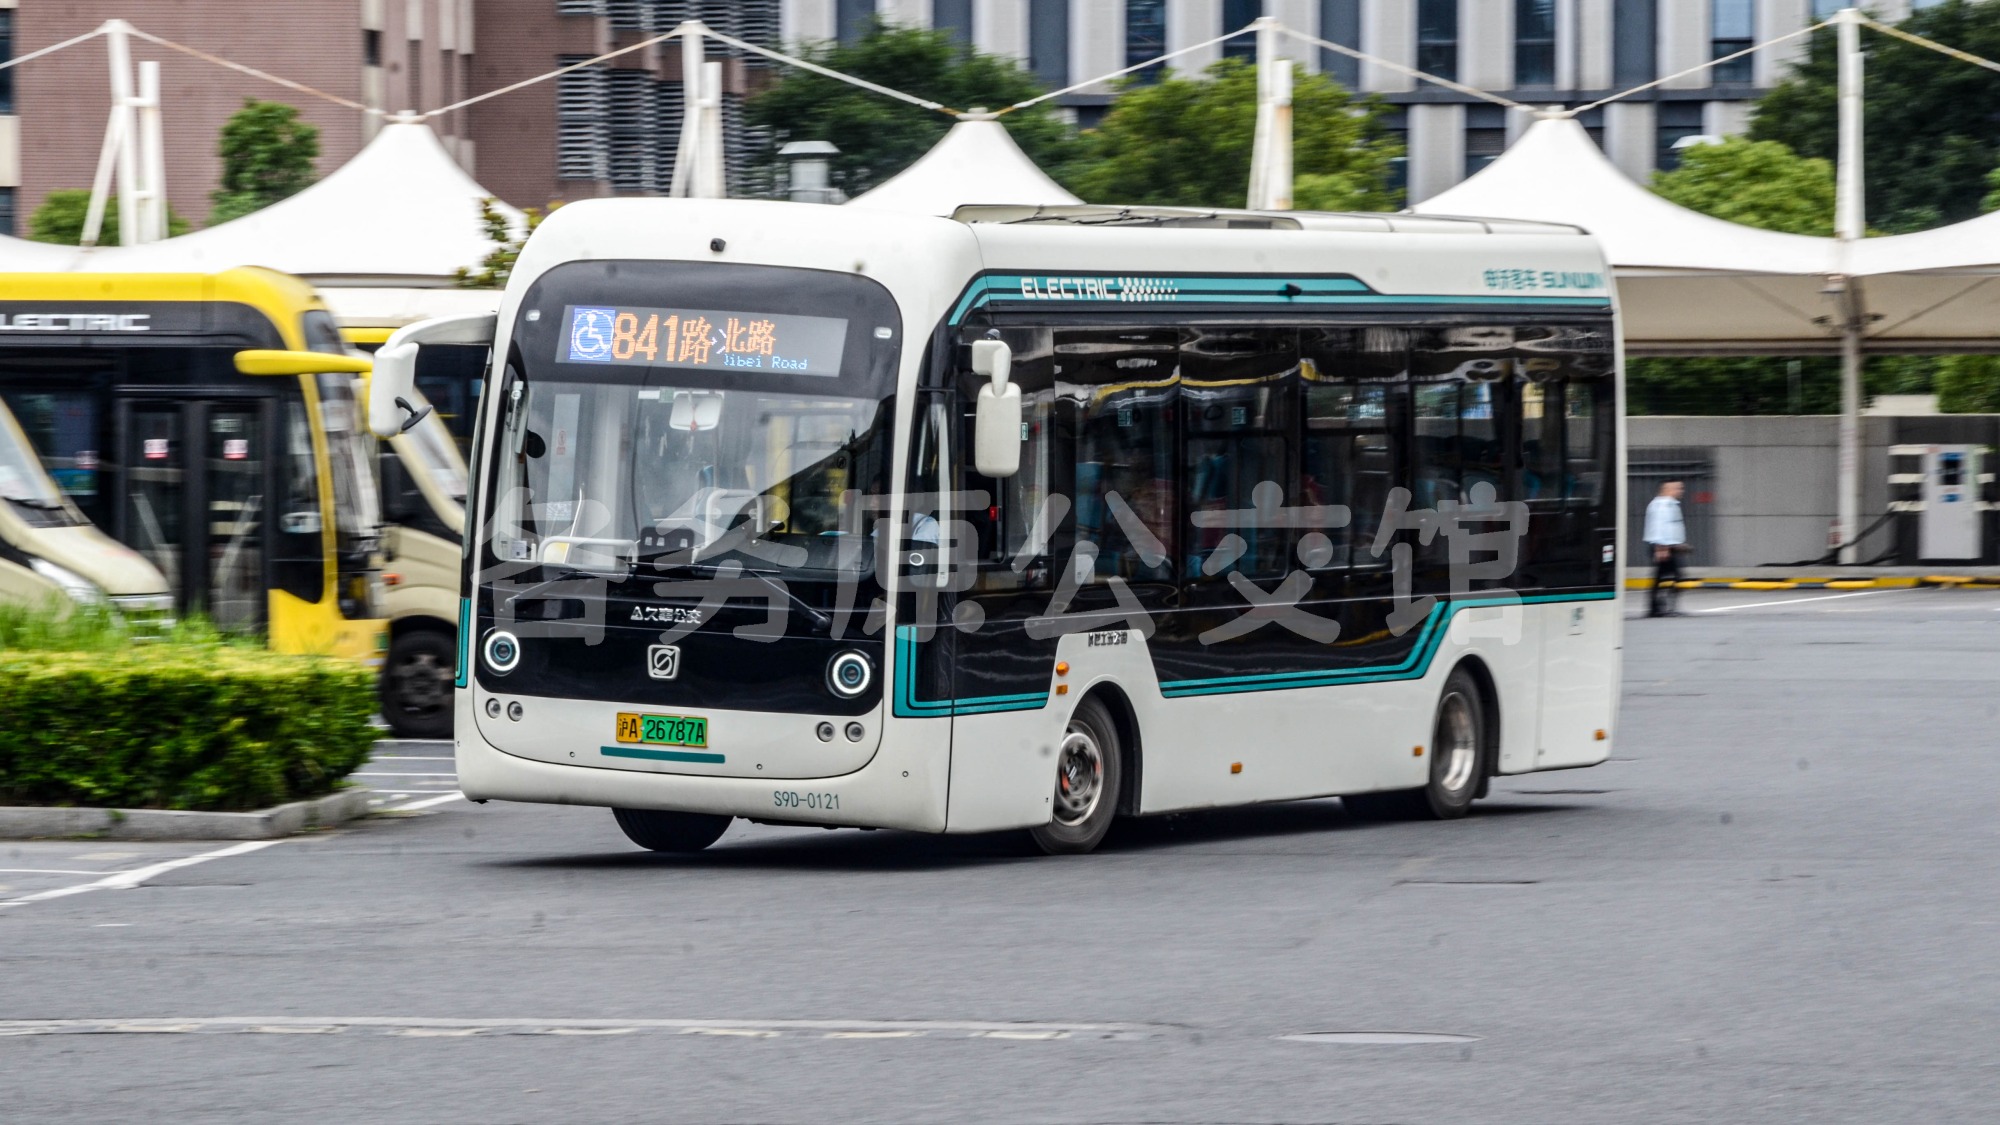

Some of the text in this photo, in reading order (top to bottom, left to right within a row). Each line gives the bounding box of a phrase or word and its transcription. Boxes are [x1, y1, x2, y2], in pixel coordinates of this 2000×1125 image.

[1020, 277, 1117, 300] ELECTRIC
[611, 312, 777, 364] 841路 北路
[771, 355, 808, 370] Road
[773, 790, 840, 810] S9D-0121
